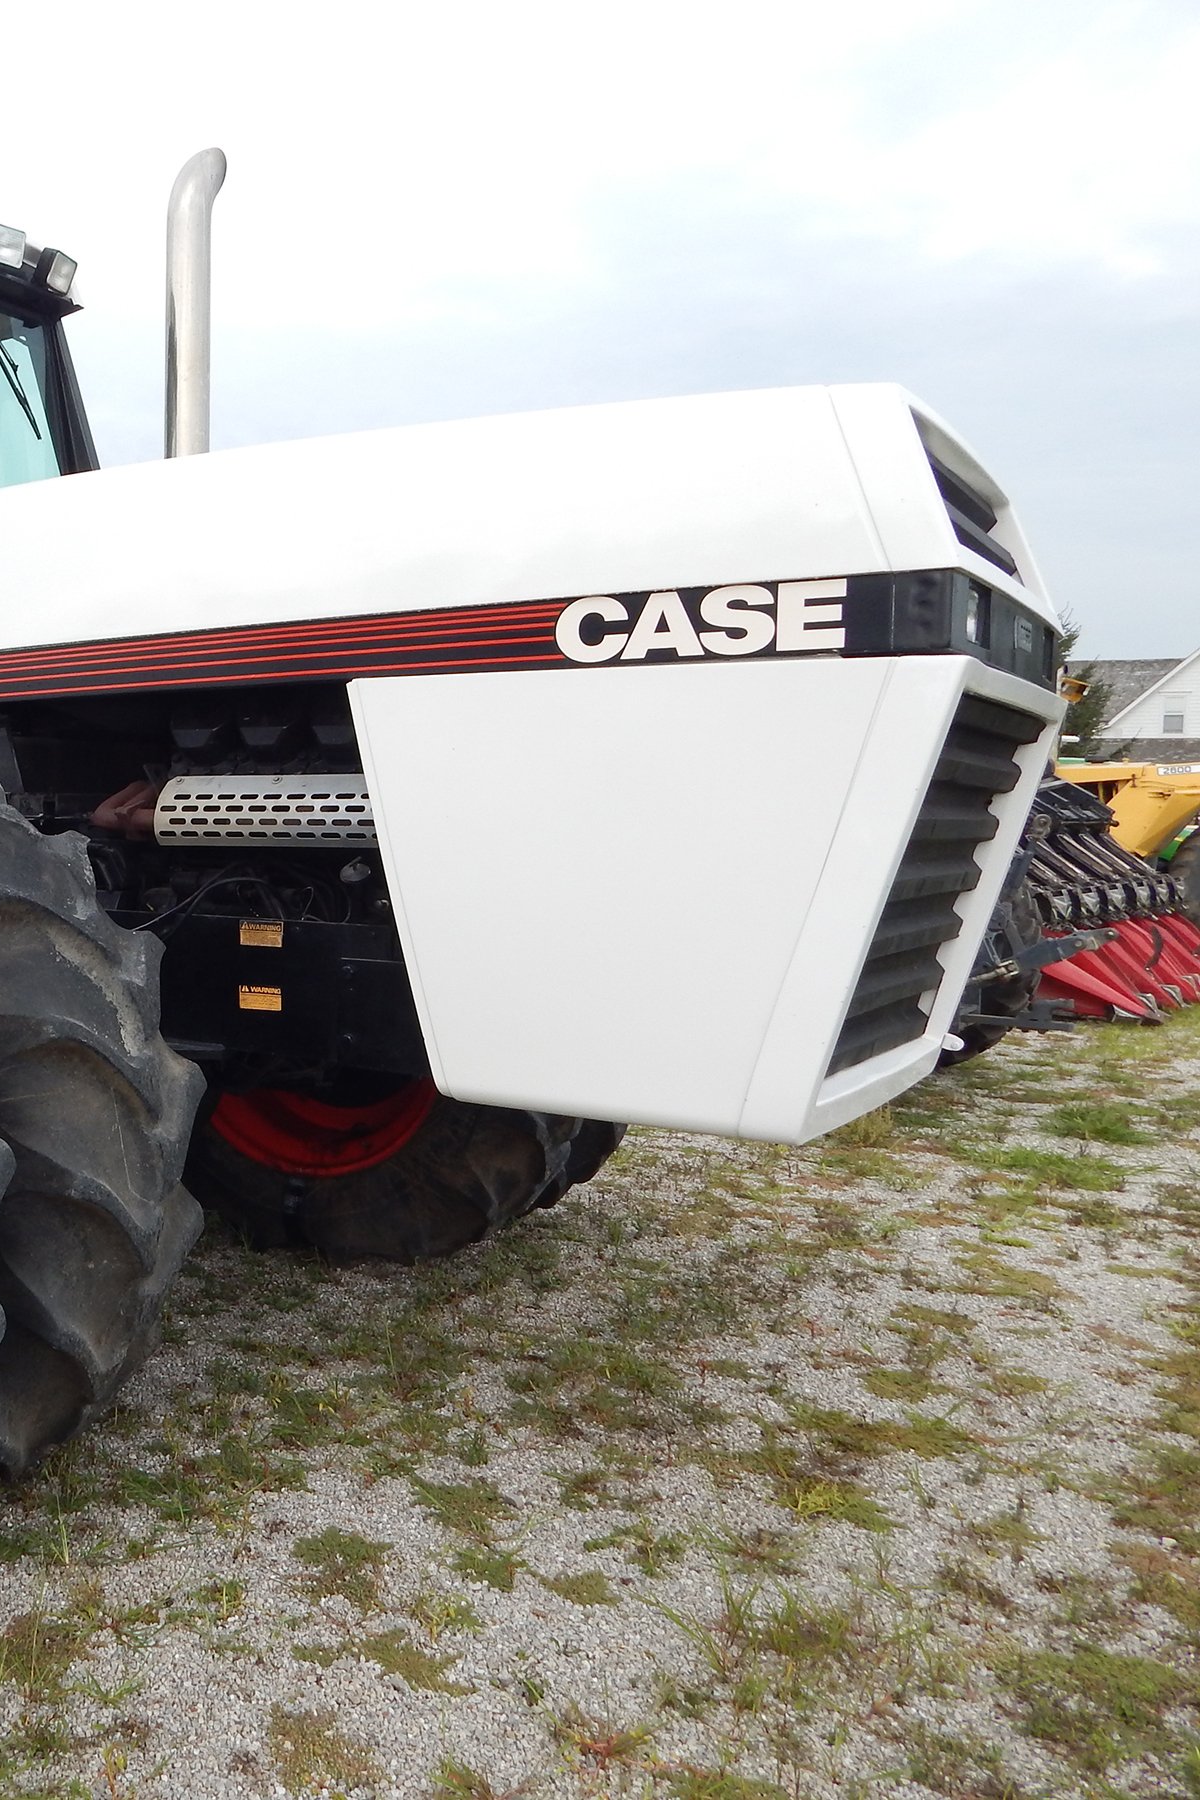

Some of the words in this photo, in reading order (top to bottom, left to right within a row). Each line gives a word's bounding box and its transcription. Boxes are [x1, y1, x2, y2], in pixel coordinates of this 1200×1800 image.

[555, 578, 847, 663] CASE
[248, 923, 282, 932] WARNING
[250, 985, 282, 995] WARNING
